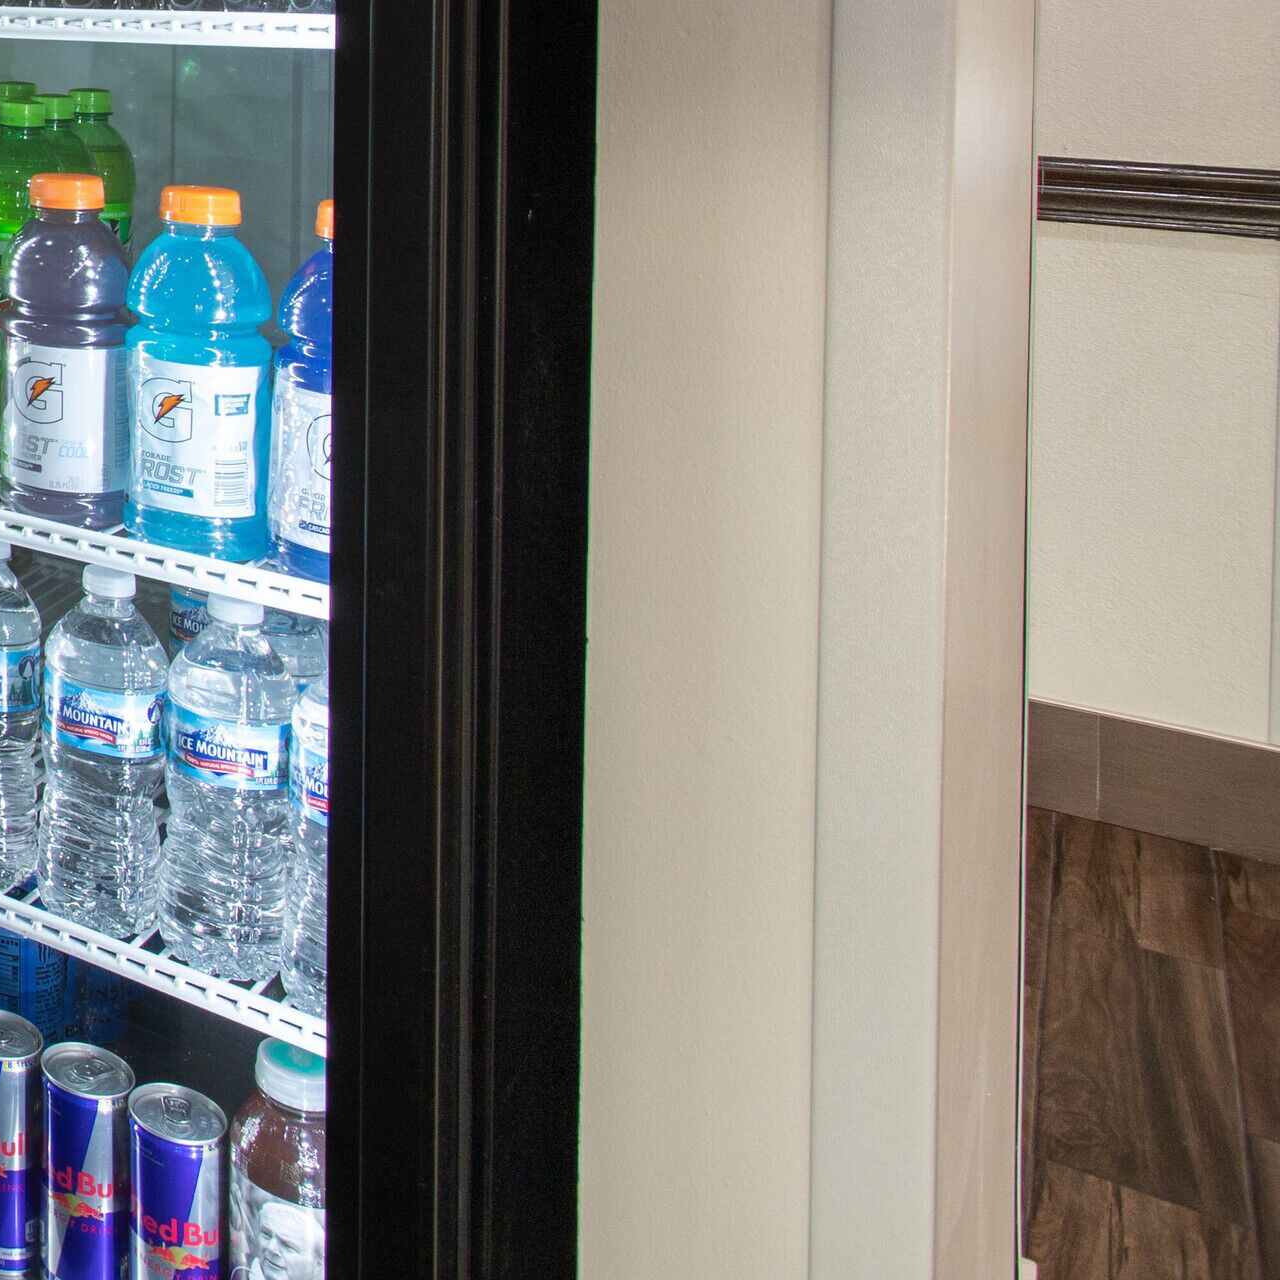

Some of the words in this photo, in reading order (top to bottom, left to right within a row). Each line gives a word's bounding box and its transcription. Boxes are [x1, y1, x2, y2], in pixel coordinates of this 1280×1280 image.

[143, 450, 171, 462] TORADE
[142, 457, 202, 486] ROST
[62, 706, 131, 736] MOUNTAIN
[177, 733, 194, 751] ICE
[196, 739, 268, 769] MOUNTAIN
[77, 1171, 114, 1199] Bu
[80, 1223, 113, 1236] DRIN
[183, 1221, 218, 1248] Bu
